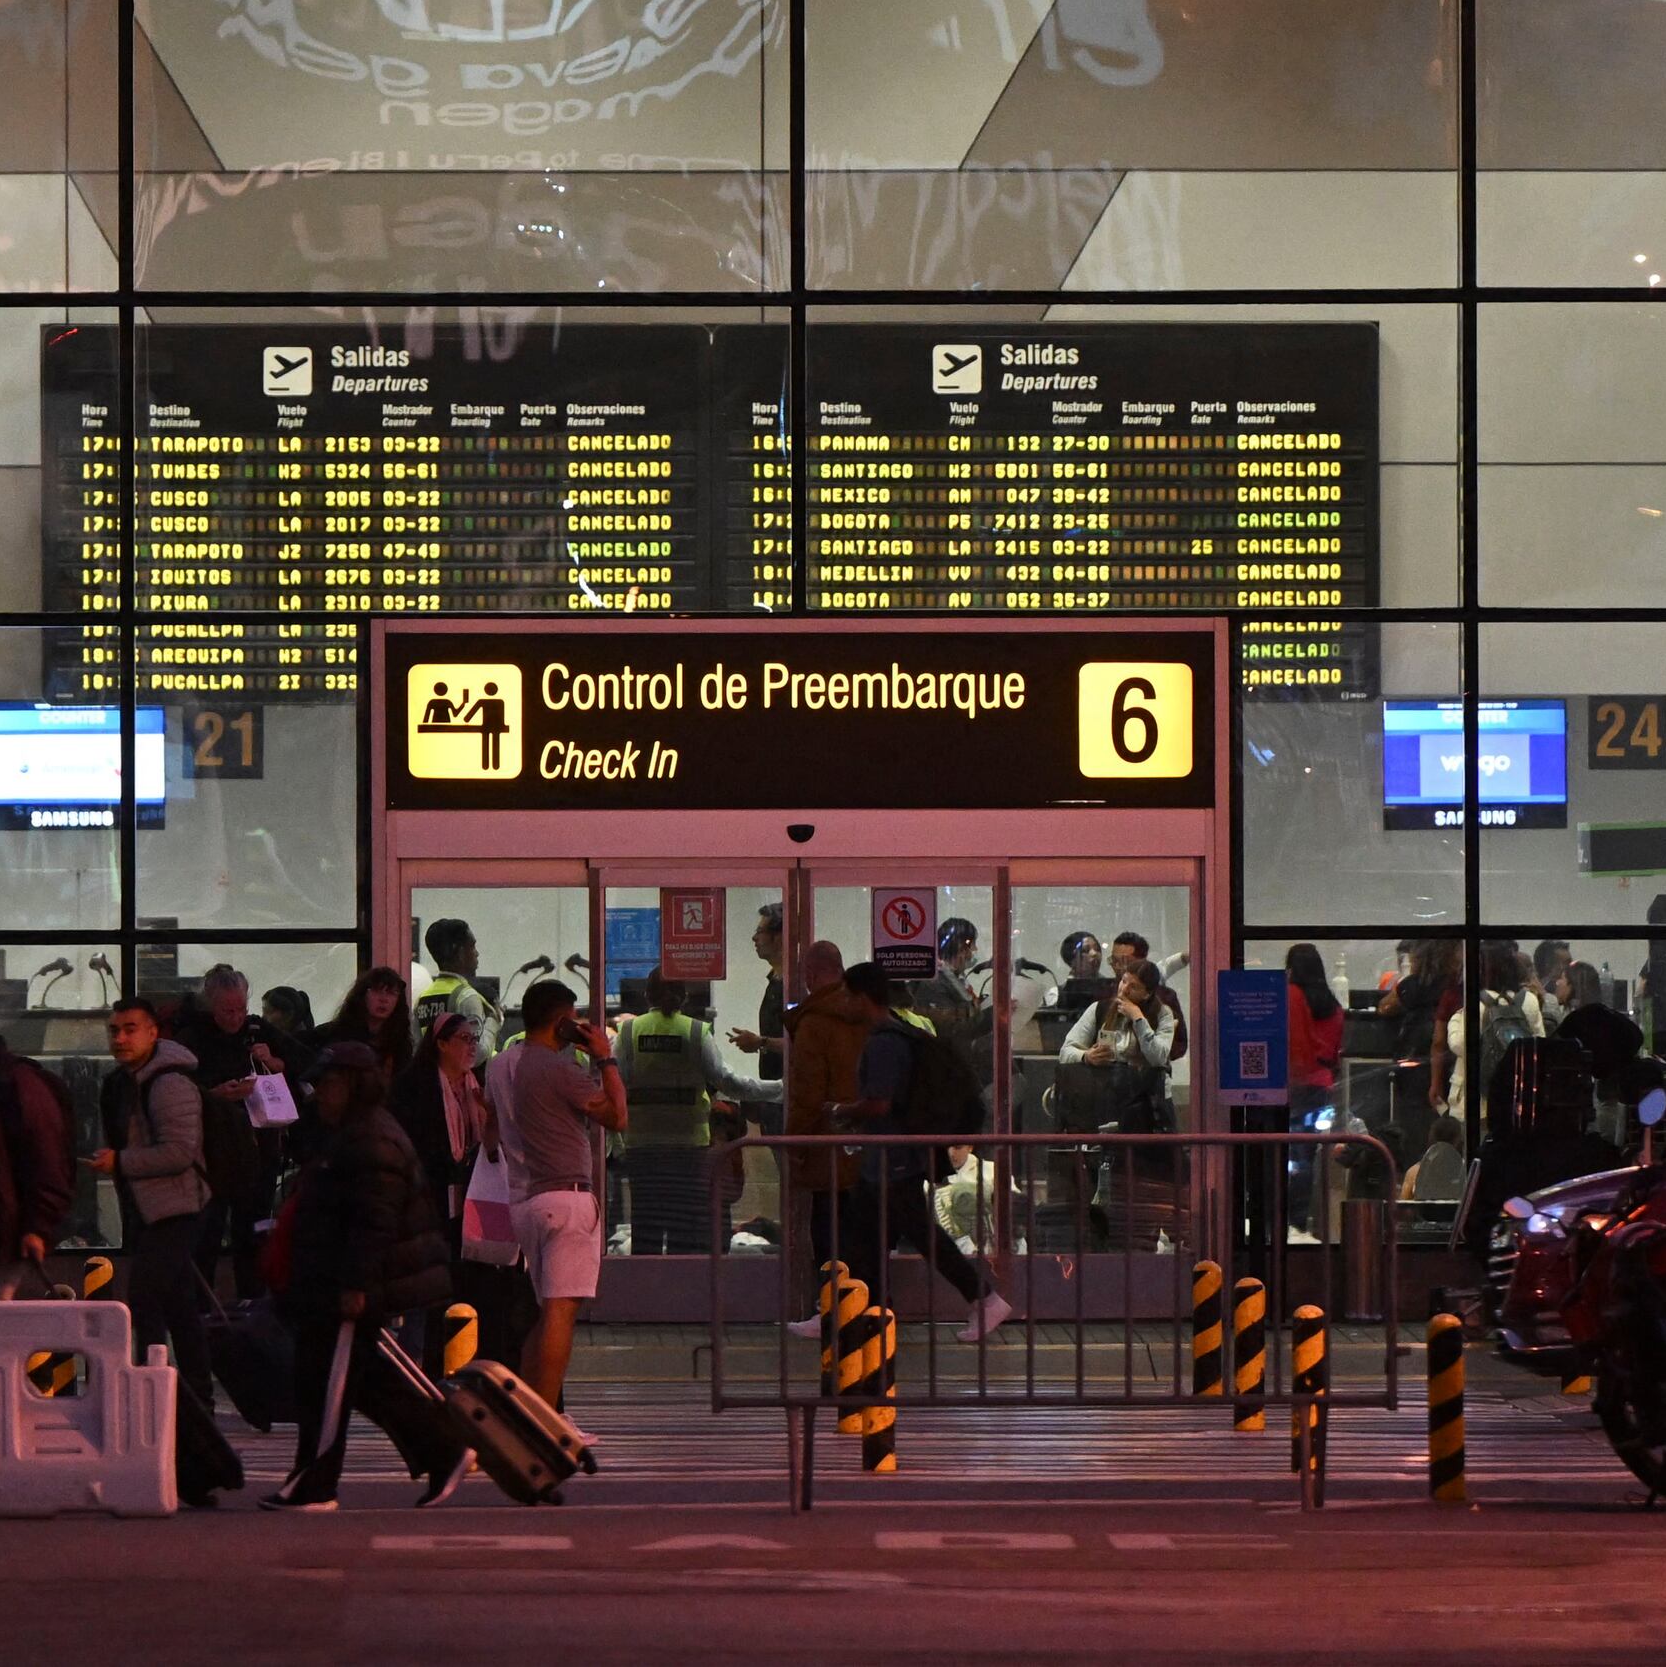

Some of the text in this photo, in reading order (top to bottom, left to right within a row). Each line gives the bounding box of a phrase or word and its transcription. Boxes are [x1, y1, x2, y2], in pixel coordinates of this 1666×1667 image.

[331, 346, 410, 367] Salidas
[1001, 344, 1079, 365] Salidas
[332, 375, 428, 395] Departures
[1001, 373, 1097, 393] Departures
[82, 404, 645, 417] Hora Destino Vuelo Mostrador Embarque Puerta Observaciones
[752, 401, 1316, 415] Hora Destino Vuelo Mostrador Embarque Puerta Observaciones
[82, 417, 605, 428] Time Destination Flight Counter Boarding Gate Remarks
[753, 414, 1275, 426] Time Destination Flight Counter Boarding Gate Remarks
[151, 435, 671, 452] TARAPOTO LA 2153 03-22 CANCELADO
[820, 434, 1341, 451] PANAMA CM 132 27-30 CANCELADO
[151, 462, 671, 479] TUMBES H2 5324 56-61 CANCELADO
[821, 462, 1340, 478] SANTIAGO H2 56-61 CANCELADO
[151, 489, 670, 506] CUSCO LA 2005 03-22 CANCELADO
[821, 488, 890, 502] MEXICO
[949, 489, 971, 503] AM
[1007, 489, 1040, 503] 047
[1238, 486, 1341, 502] CANCELADO
[151, 515, 671, 532] CUSCO LA 2017 03-22 CANCELADO
[821, 512, 1340, 529] BOGOTA P5 7412 23-25 CANCELADO
[151, 544, 243, 559] TARAPOTO
[279, 544, 301, 559] JZ
[383, 544, 440, 558] 47-49
[567, 542, 671, 557] CANCELADO
[821, 538, 1340, 555] SANTIAGO LA 2415 03-22 25 CANCELADO
[279, 570, 301, 584] LA
[326, 570, 370, 584] 2676
[383, 569, 439, 584] 03-22
[568, 568, 671, 584] CANCELADO
[821, 566, 913, 581] MEDELLIN
[1007, 566, 1039, 580] 432
[1237, 564, 1341, 580] CANCELADO
[151, 595, 439, 611] PIURA LA 2310 03-22
[822, 593, 889, 607] BOGOTA
[949, 593, 971, 607] AV
[1007, 593, 1040, 608] 052
[1238, 590, 1341, 606] CANCELADO
[152, 648, 301, 663] AREQUIPA H2
[152, 675, 300, 689] PUCALLPA 2I
[541, 662, 1025, 719] Control de Preembarque
[1109, 676, 1160, 764] 6
[1596, 702, 1663, 757] 24
[194, 712, 255, 766] 21
[539, 740, 679, 780] Check In
[1440, 755, 1511, 777] wgo
[31, 810, 114, 827] SAMSUNG
[1435, 810, 1516, 826] SAUNG
[876, 951, 933, 959] SOLO PERSONAL
[883, 959, 927, 967] AUTORIZADO
